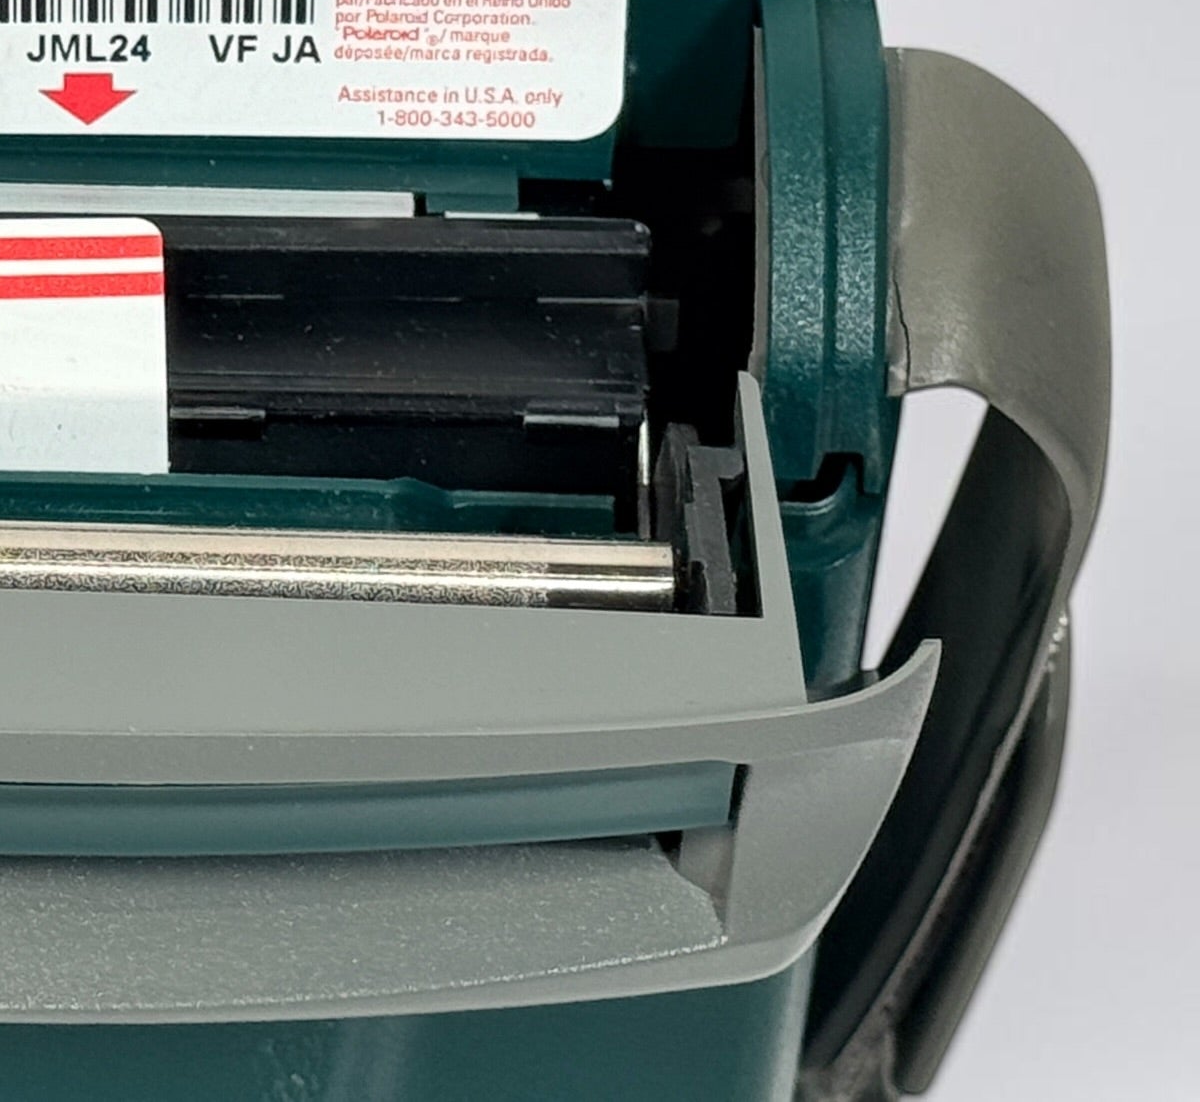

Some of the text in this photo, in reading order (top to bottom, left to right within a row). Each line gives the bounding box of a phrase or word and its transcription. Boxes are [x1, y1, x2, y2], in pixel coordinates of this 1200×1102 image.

[335, 9, 536, 27] por Polaroid Corporation.
[450, 30, 511, 46] marque
[27, 34, 151, 63] JML24
[209, 35, 258, 62] VF
[272, 35, 321, 63] JA
[466, 47, 554, 64] registrada.
[337, 85, 563, 107] Assistance in U.S.A. only
[377, 109, 536, 128] 1-800-343-5000
